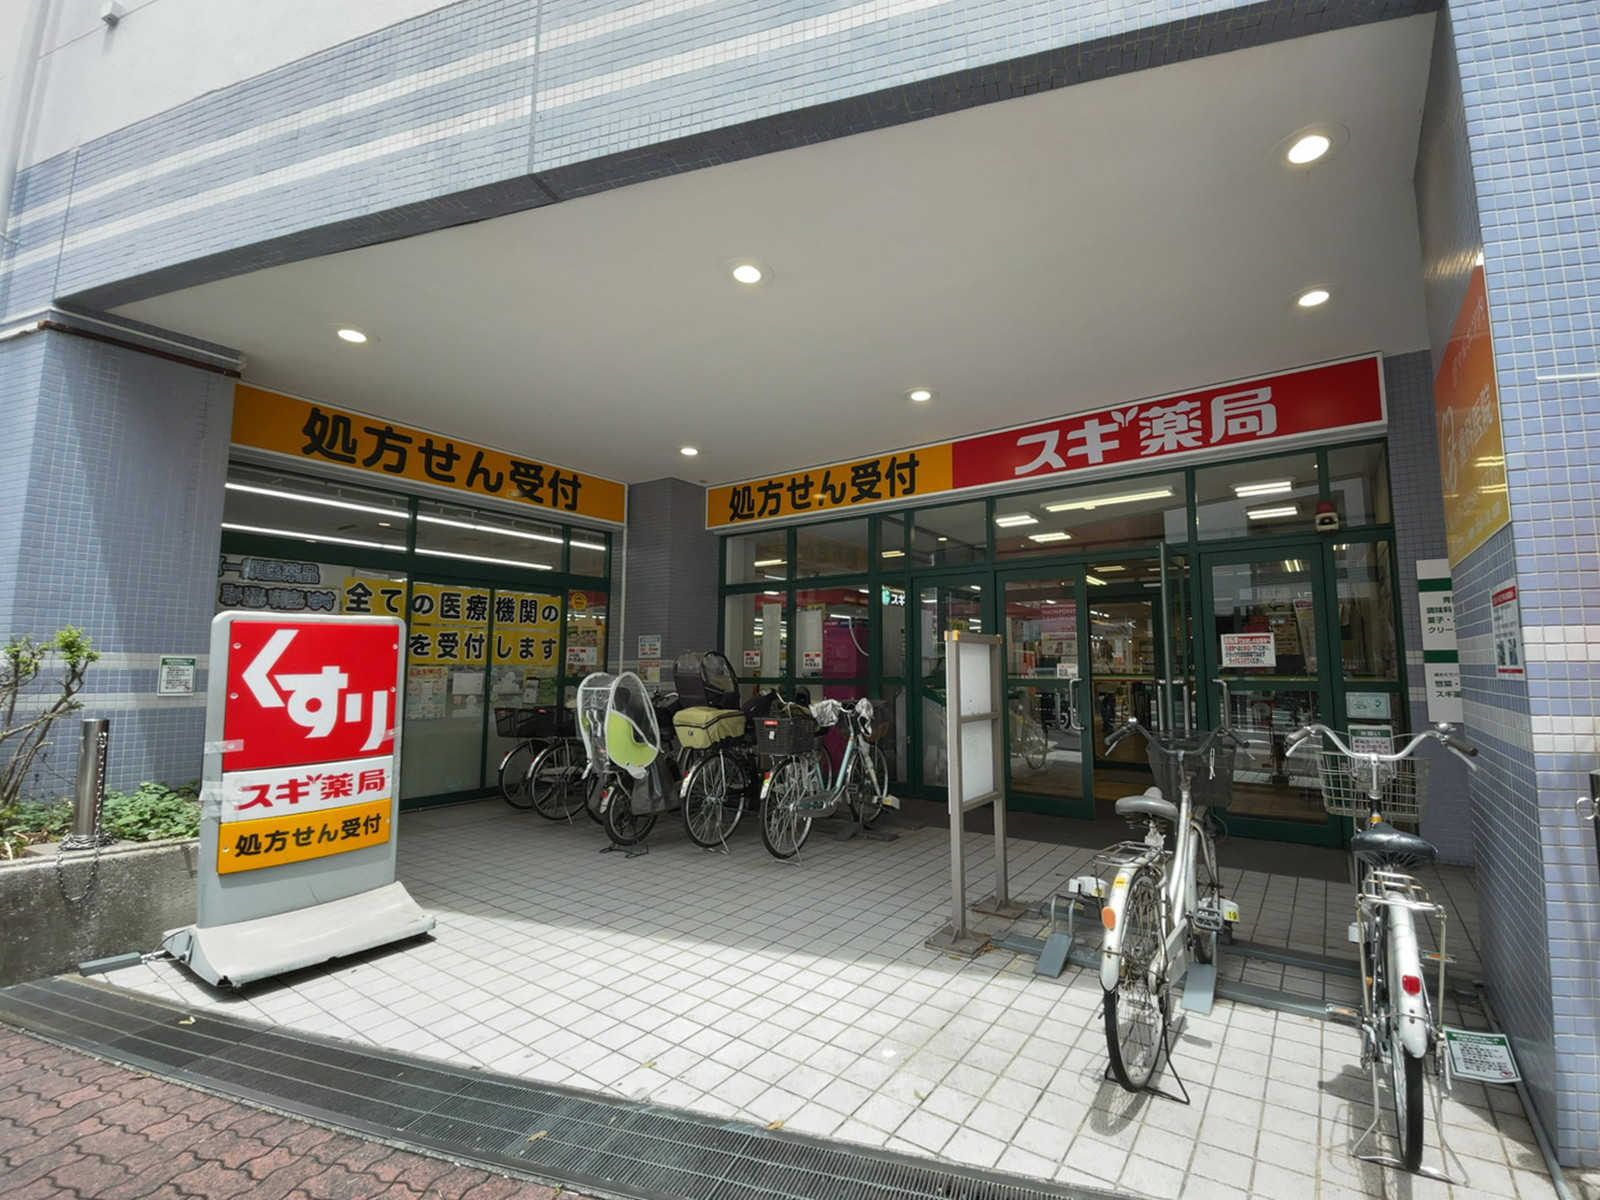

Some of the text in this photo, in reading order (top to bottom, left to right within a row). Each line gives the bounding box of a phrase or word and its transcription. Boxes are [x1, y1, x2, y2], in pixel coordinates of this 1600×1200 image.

[302, 407, 582, 511] 処方せん受付
[1014, 387, 1277, 476] スギ薬局
[729, 453, 920, 522] 処方せん受付
[344, 582, 559, 624] 全ての医療機関の
[409, 632, 558, 659] を受付します
[242, 629, 388, 751] くすり
[235, 768, 386, 811] スギ薬局
[235, 815, 382, 858] 処方せん受付
